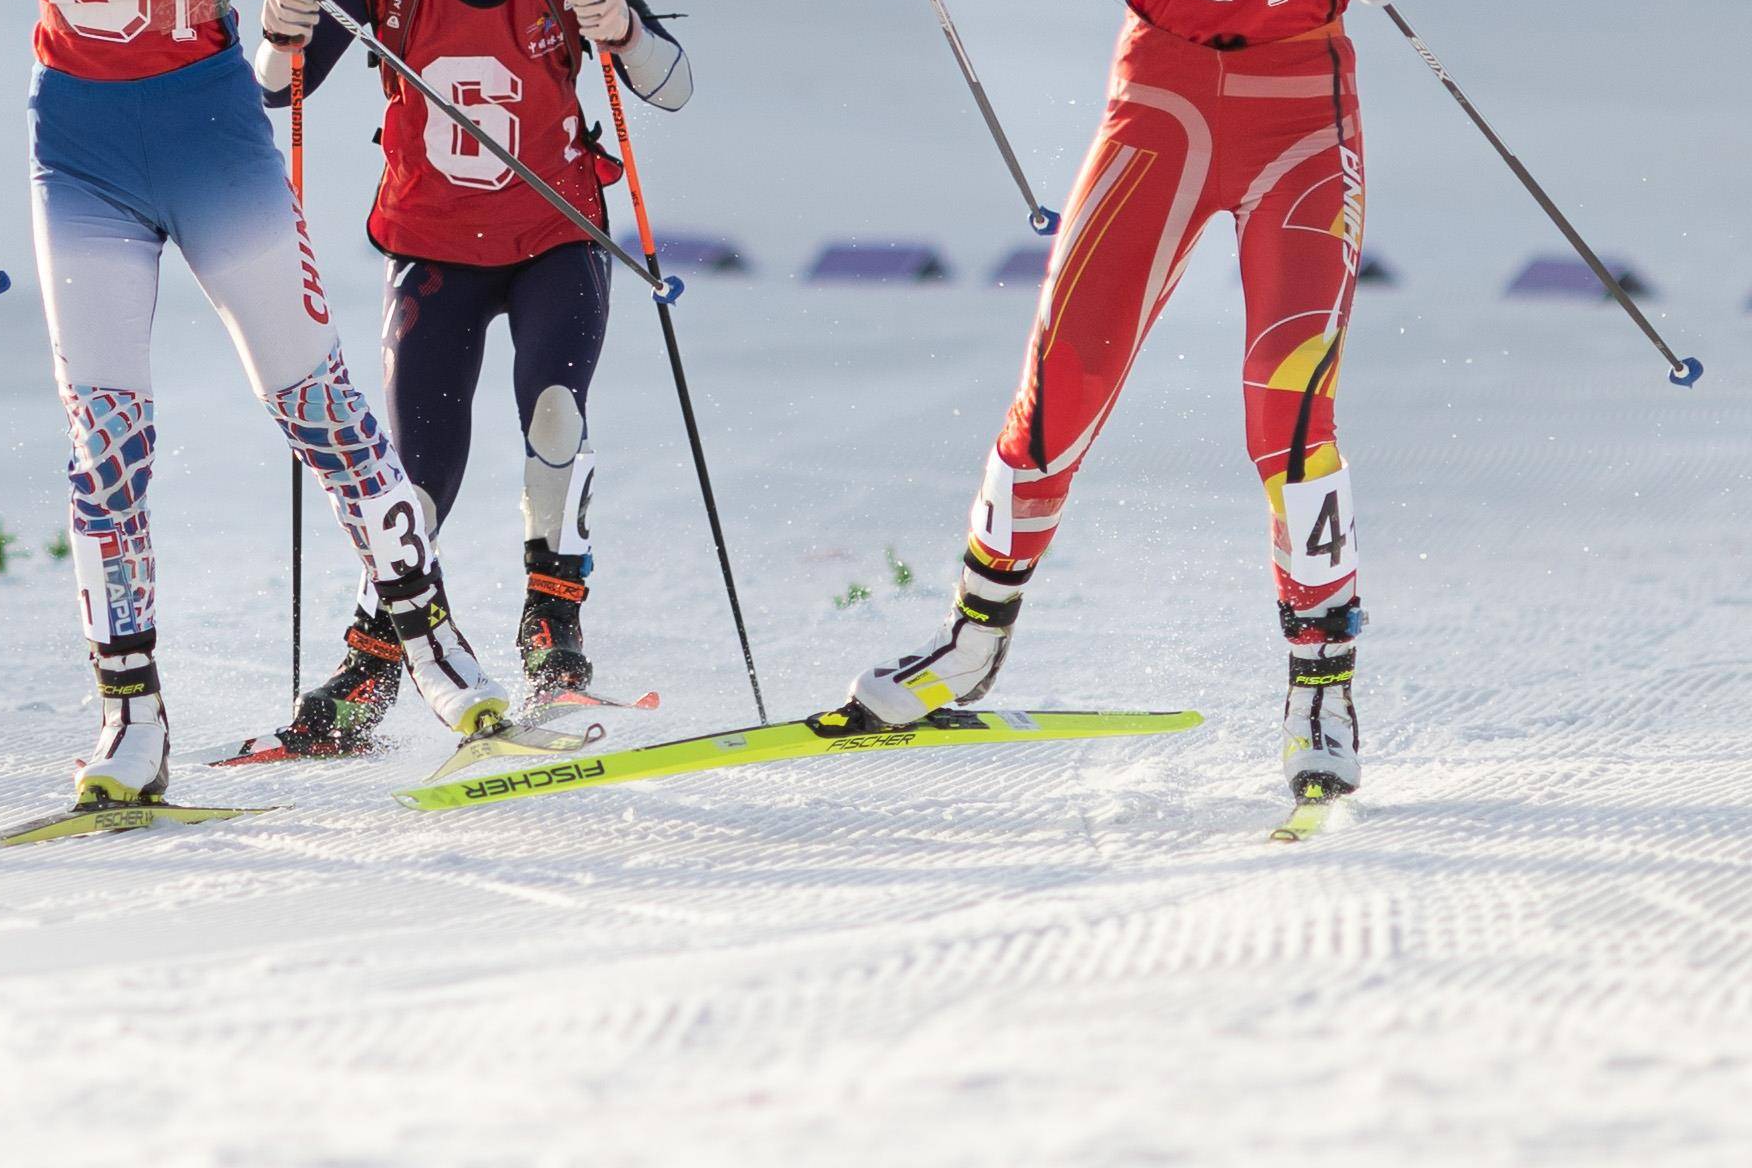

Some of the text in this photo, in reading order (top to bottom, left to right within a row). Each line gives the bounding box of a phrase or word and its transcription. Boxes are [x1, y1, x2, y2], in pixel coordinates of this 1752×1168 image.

[420, 55, 523, 191] 6
[382, 500, 426, 577] 3
[1306, 489, 1346, 568] 4
[462, 759, 606, 799] FISCHER
[826, 733, 916, 753] FISCHER
